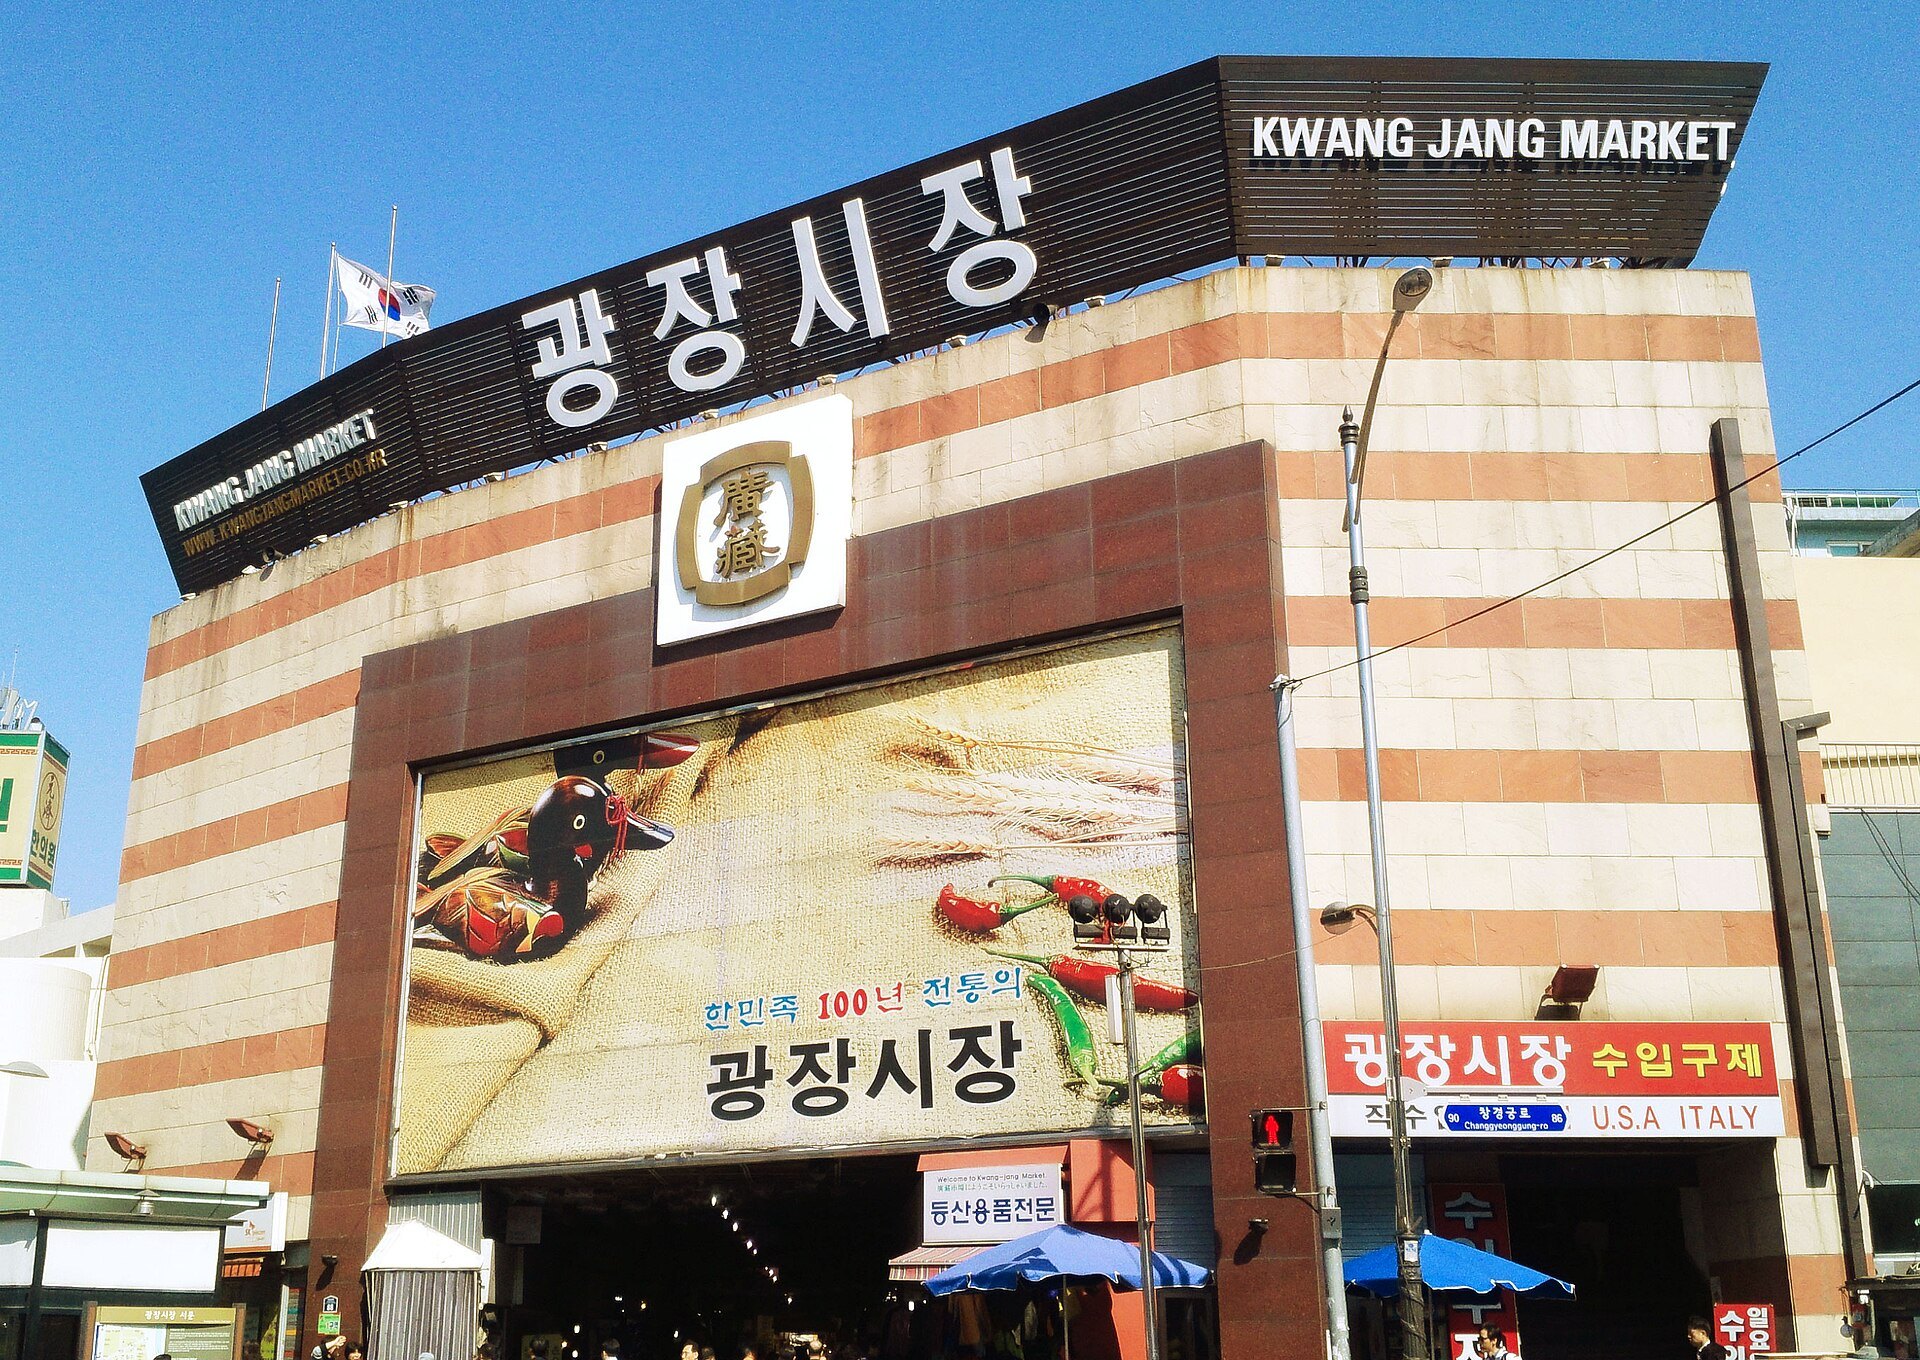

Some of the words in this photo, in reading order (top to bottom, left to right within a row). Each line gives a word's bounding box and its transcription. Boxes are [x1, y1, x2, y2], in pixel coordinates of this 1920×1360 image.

[1253, 116, 1413, 159] KWANG
[1427, 117, 1545, 160] JANG
[1560, 119, 1736, 161] MARKET
[521, 146, 1038, 428] 광장시장
[173, 476, 245, 532] KWANG
[243, 449, 295, 499] JANG
[292, 408, 377, 473] MARKET
[704, 994, 800, 1031] 한민족
[817, 981, 904, 1020] 100년
[923, 966, 1022, 1008] 전통의
[706, 1020, 1022, 1121] 광장시장
[1344, 1034, 1572, 1086] 광장시장
[1592, 1042, 1763, 1078] 수입구제
[1448, 1113, 1460, 1123] 90
[1464, 1121, 1549, 1132] Changgyeonggung-ro
[1478, 1106, 1532, 1120] 창경궁로
[1551, 1113, 1563, 1123] 86
[1592, 1105, 1661, 1130] U.S.A
[1680, 1105, 1759, 1130] ITALY
[1021, 1172, 1045, 1180] Market
[930, 1196, 1056, 1226] 등산용품전문
[144, 1310, 176, 1321] 광장시장
